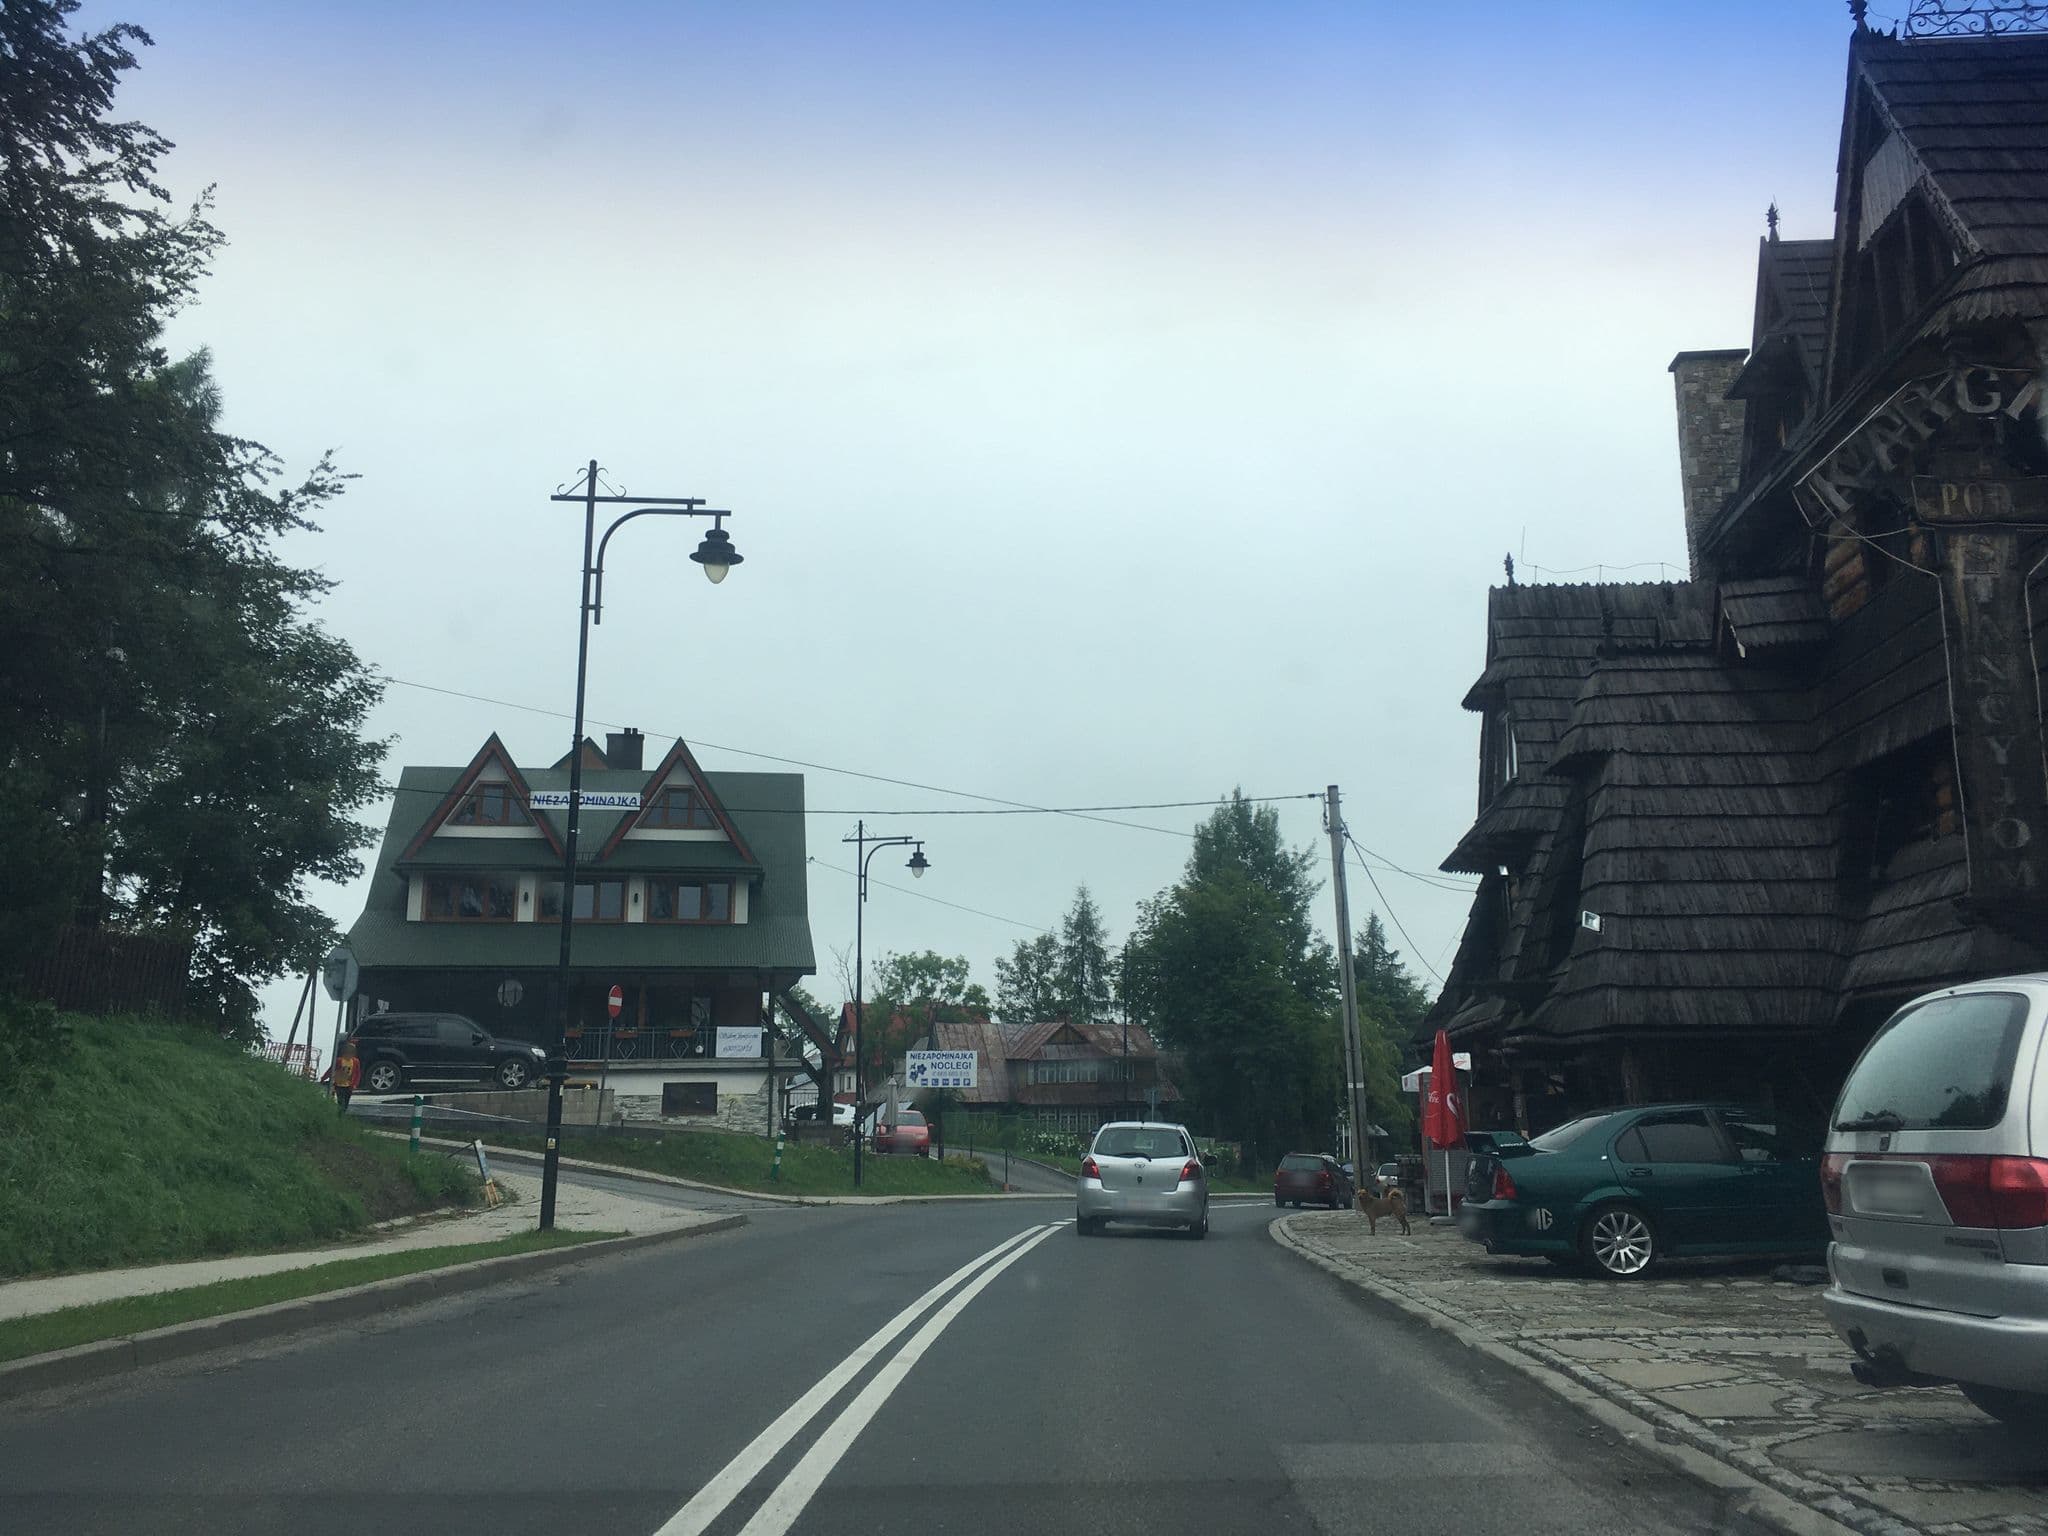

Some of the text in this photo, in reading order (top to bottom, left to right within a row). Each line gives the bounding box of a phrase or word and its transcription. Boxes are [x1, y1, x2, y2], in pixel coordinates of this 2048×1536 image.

[533, 795, 638, 807] NIEZAOMINAJKA
[910, 1052, 974, 1060] NIEZAPOMINAJKA
[931, 1061, 972, 1070] NOCLEGI
